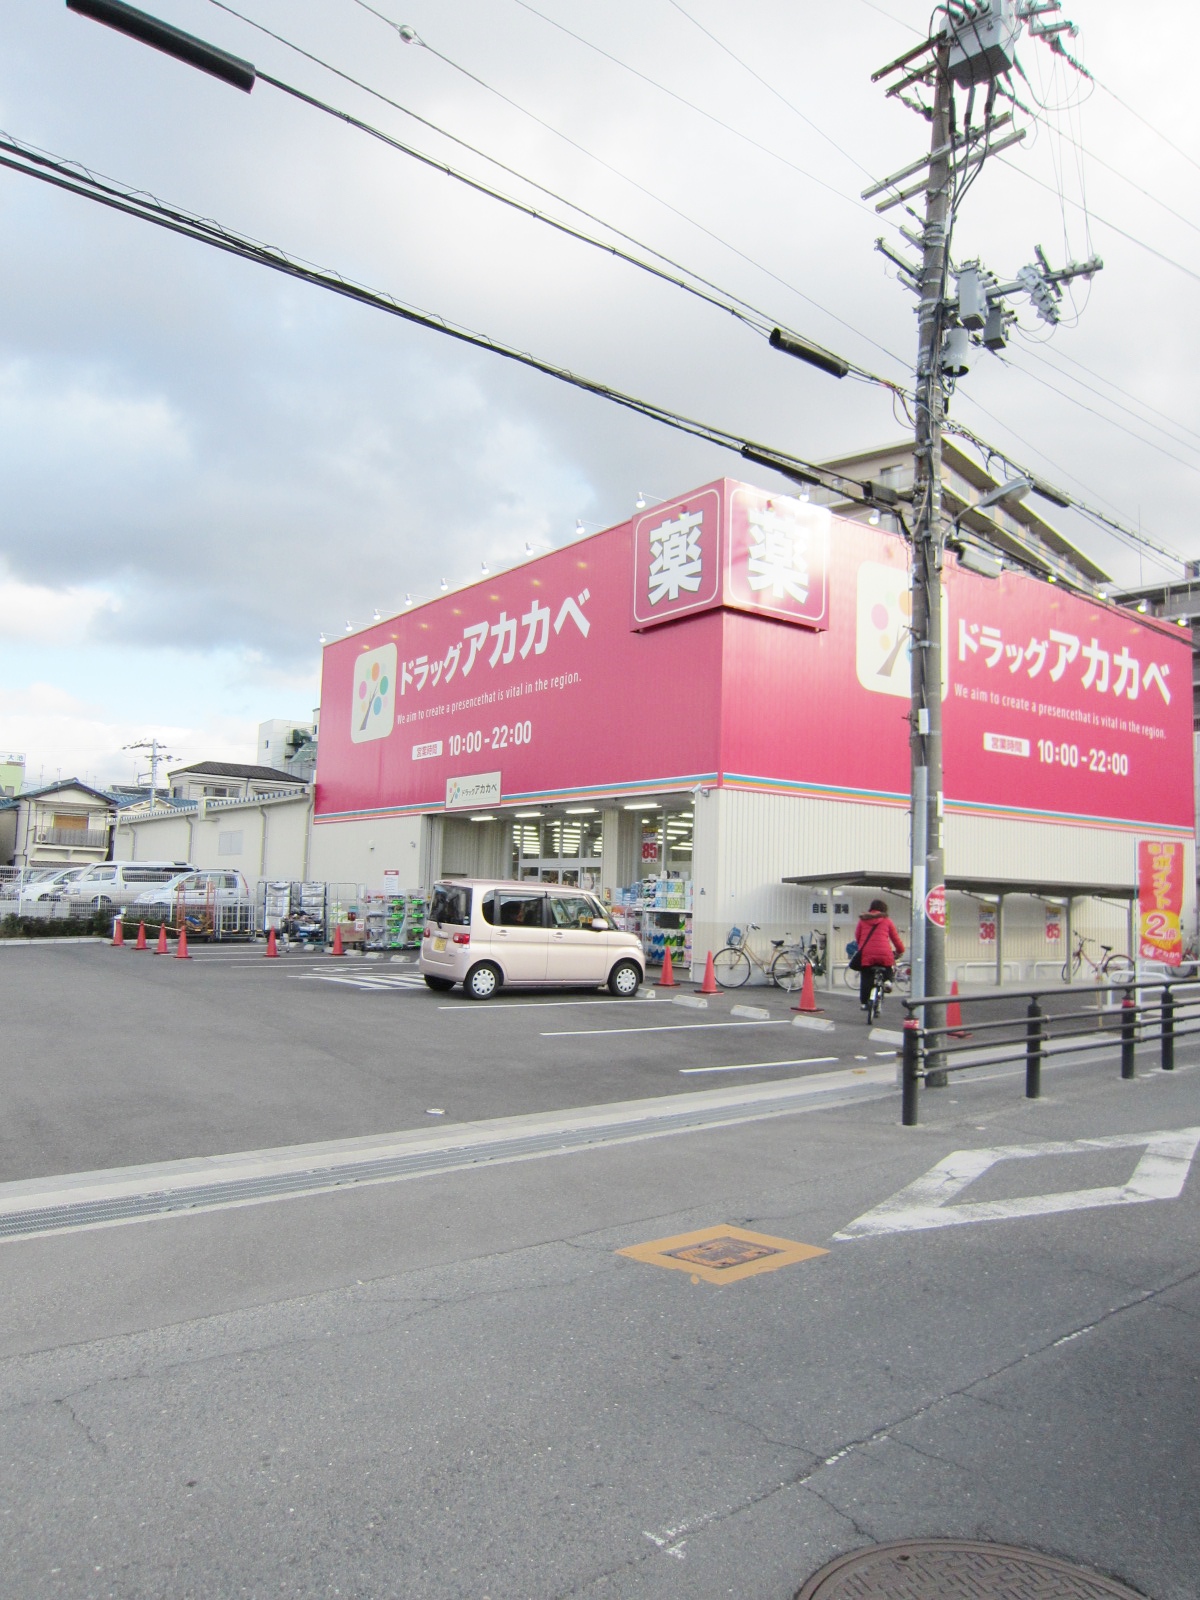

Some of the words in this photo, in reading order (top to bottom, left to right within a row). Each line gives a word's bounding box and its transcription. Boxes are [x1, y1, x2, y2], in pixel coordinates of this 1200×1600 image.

[648, 509, 703, 606] 薬
[747, 508, 809, 604] 薬
[400, 588, 591, 695] ドラッグアカカベ
[957, 618, 1171, 706] ドラッグアカカベ
[397, 714, 405, 724] We
[406, 712, 417, 723] aim
[418, 710, 424, 720] to
[425, 705, 445, 718] create
[446, 704, 450, 713] a
[497, 689, 504, 701] is
[506, 682, 523, 698] vital
[525, 682, 533, 694] in
[535, 678, 548, 691] the
[550, 672, 582, 690] region.
[954, 682, 968, 698] We
[970, 688, 988, 702] aim
[990, 692, 1000, 705] to
[1001, 695, 1029, 711] create
[1031, 701, 1037, 712] a
[1092, 713, 1099, 725] is
[1100, 716, 1118, 729] vital
[1119, 719, 1127, 731] in
[1128, 720, 1140, 734] the
[1141, 725, 1166, 739] region.
[461, 784, 498, 797] ドラッグアカカベ
[642, 842, 657, 859] 85
[812, 903, 849, 914] 自転置場
[1152, 856, 1171, 909] ポイント
[979, 922, 995, 940] 38
[1045, 923, 1061, 939] 85
